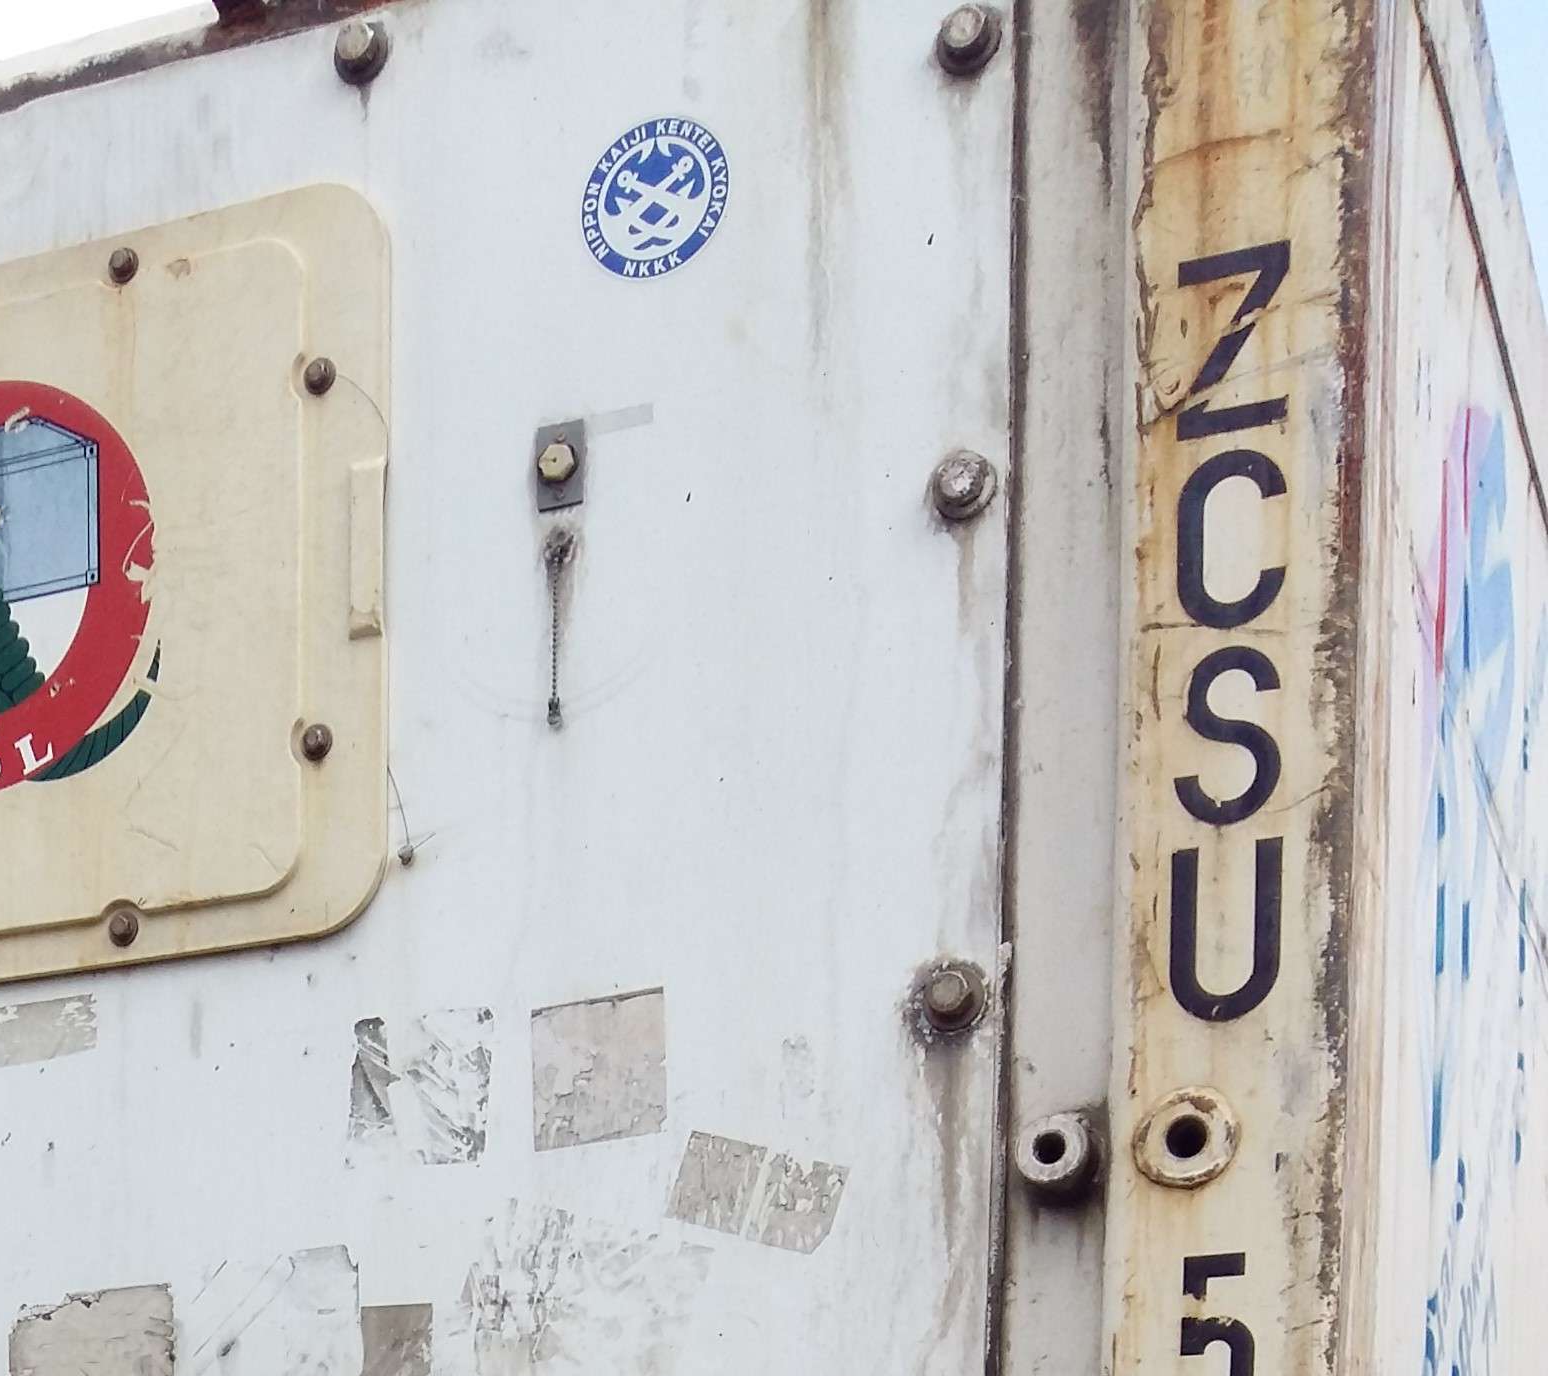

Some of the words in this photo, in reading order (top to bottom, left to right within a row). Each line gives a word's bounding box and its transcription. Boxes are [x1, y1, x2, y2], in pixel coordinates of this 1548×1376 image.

[583, 182, 610, 260] NIPPON
[598, 126, 647, 173] KAIJI
[656, 119, 716, 154] KENTEI
[698, 156, 727, 237] KYOKAI
[623, 251, 684, 277] NKKK
[1168, 240, 1291, 1022] ZCSU
